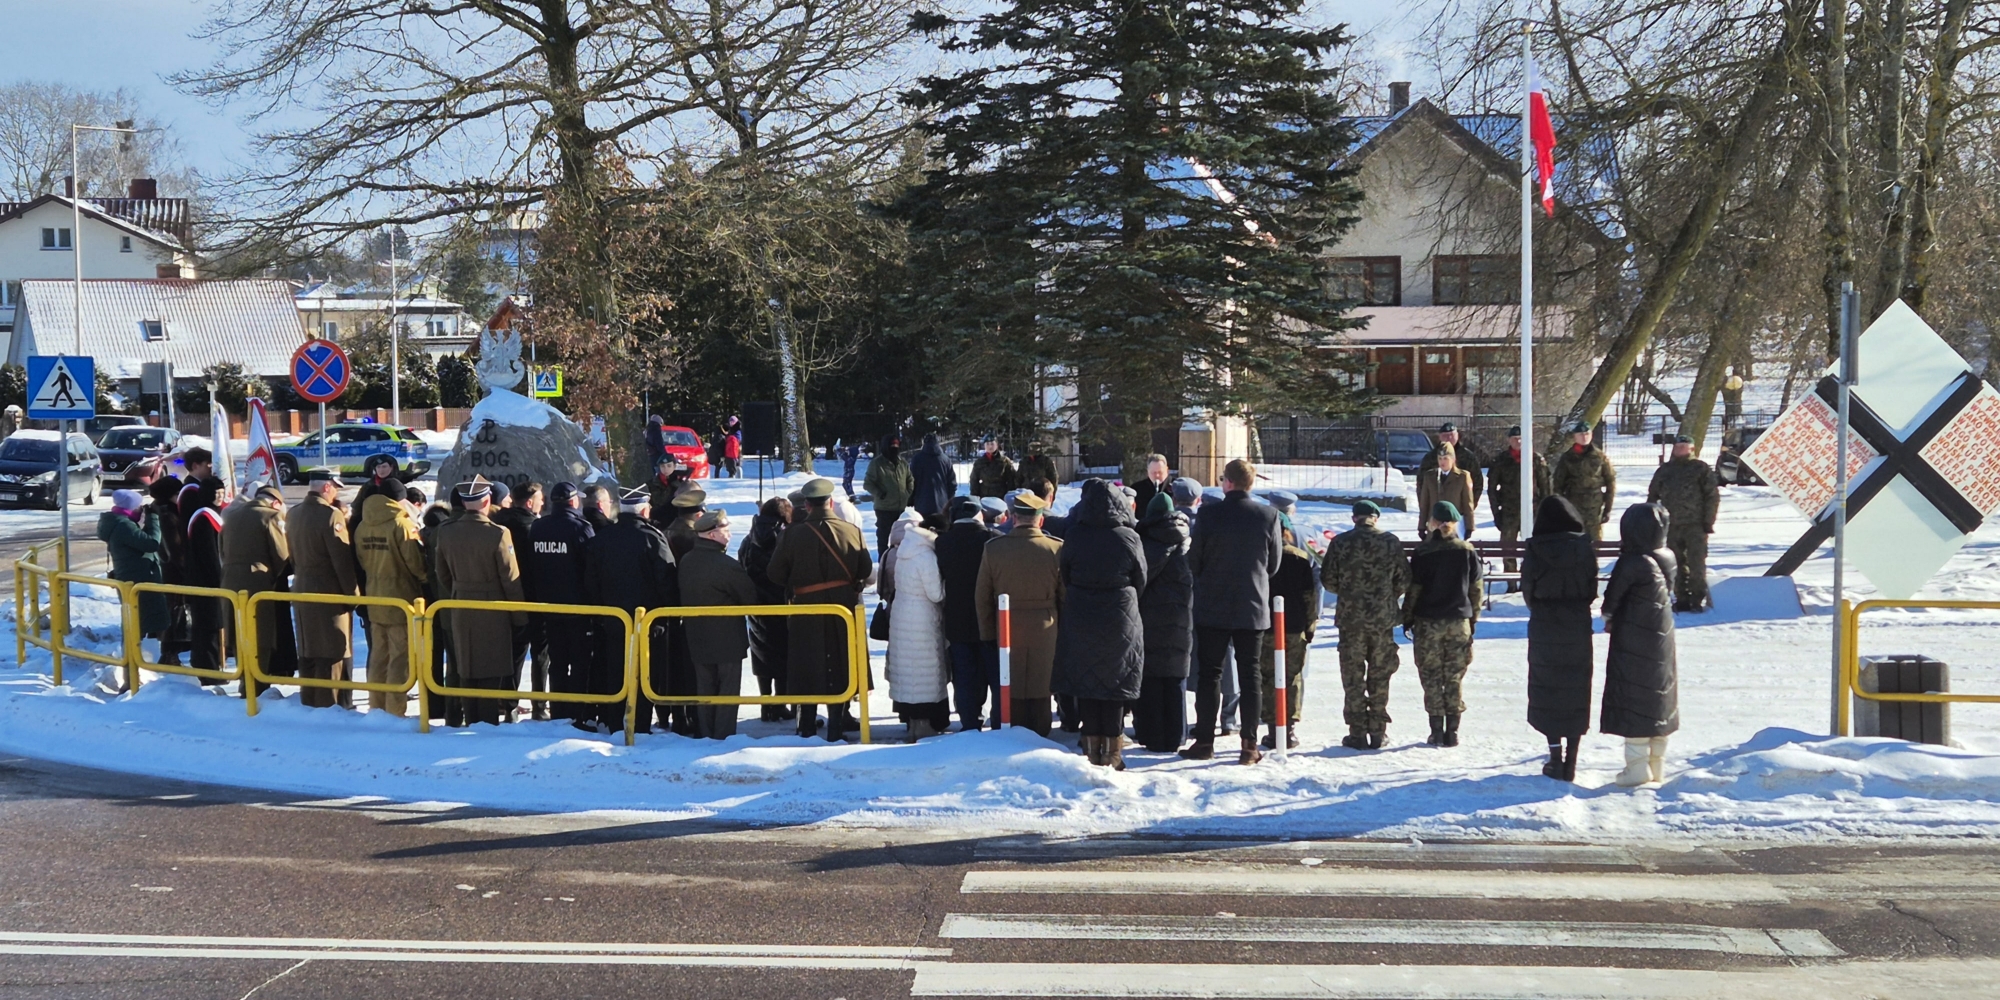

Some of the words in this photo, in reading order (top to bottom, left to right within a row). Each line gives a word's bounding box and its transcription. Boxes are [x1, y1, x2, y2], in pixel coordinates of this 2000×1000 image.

[1773, 426, 1805, 457] BRZMIĄ
[1784, 415, 1852, 480] ZAMORDOWANH
[1790, 410, 1822, 441] POLSKICH
[1824, 442, 1858, 475] OFICÓW
[1796, 405, 1815, 423] NAD
[1820, 428, 1862, 469] GROAMI
[1945, 431, 1977, 462] BISKUP
[1963, 409, 1983, 429] JAKO
[1970, 442, 1983, 455] CO
[471, 449, 510, 468] BÓG
[1757, 442, 1768, 452] OD
[1767, 452, 1808, 490] WSZELKIEGO
[1806, 488, 1825, 506] LĘKU
[1762, 437, 1830, 501] WYZWALAJĄC
[1768, 432, 1798, 460] NASZYCH
[1797, 459, 1835, 495] SUMIENIACH
[1930, 442, 1969, 480] GENERAŁ
[1970, 480, 1999, 508] BRONI
[1936, 436, 1966, 465] WOJSKA
[1762, 457, 1799, 492] OBLICZU
[1802, 495, 1820, 512] ZŁA
[1923, 448, 1962, 486] TADEUSZ
[1961, 484, 1992, 515] PŁOSKI
[534, 541, 567, 554] POLICJA
